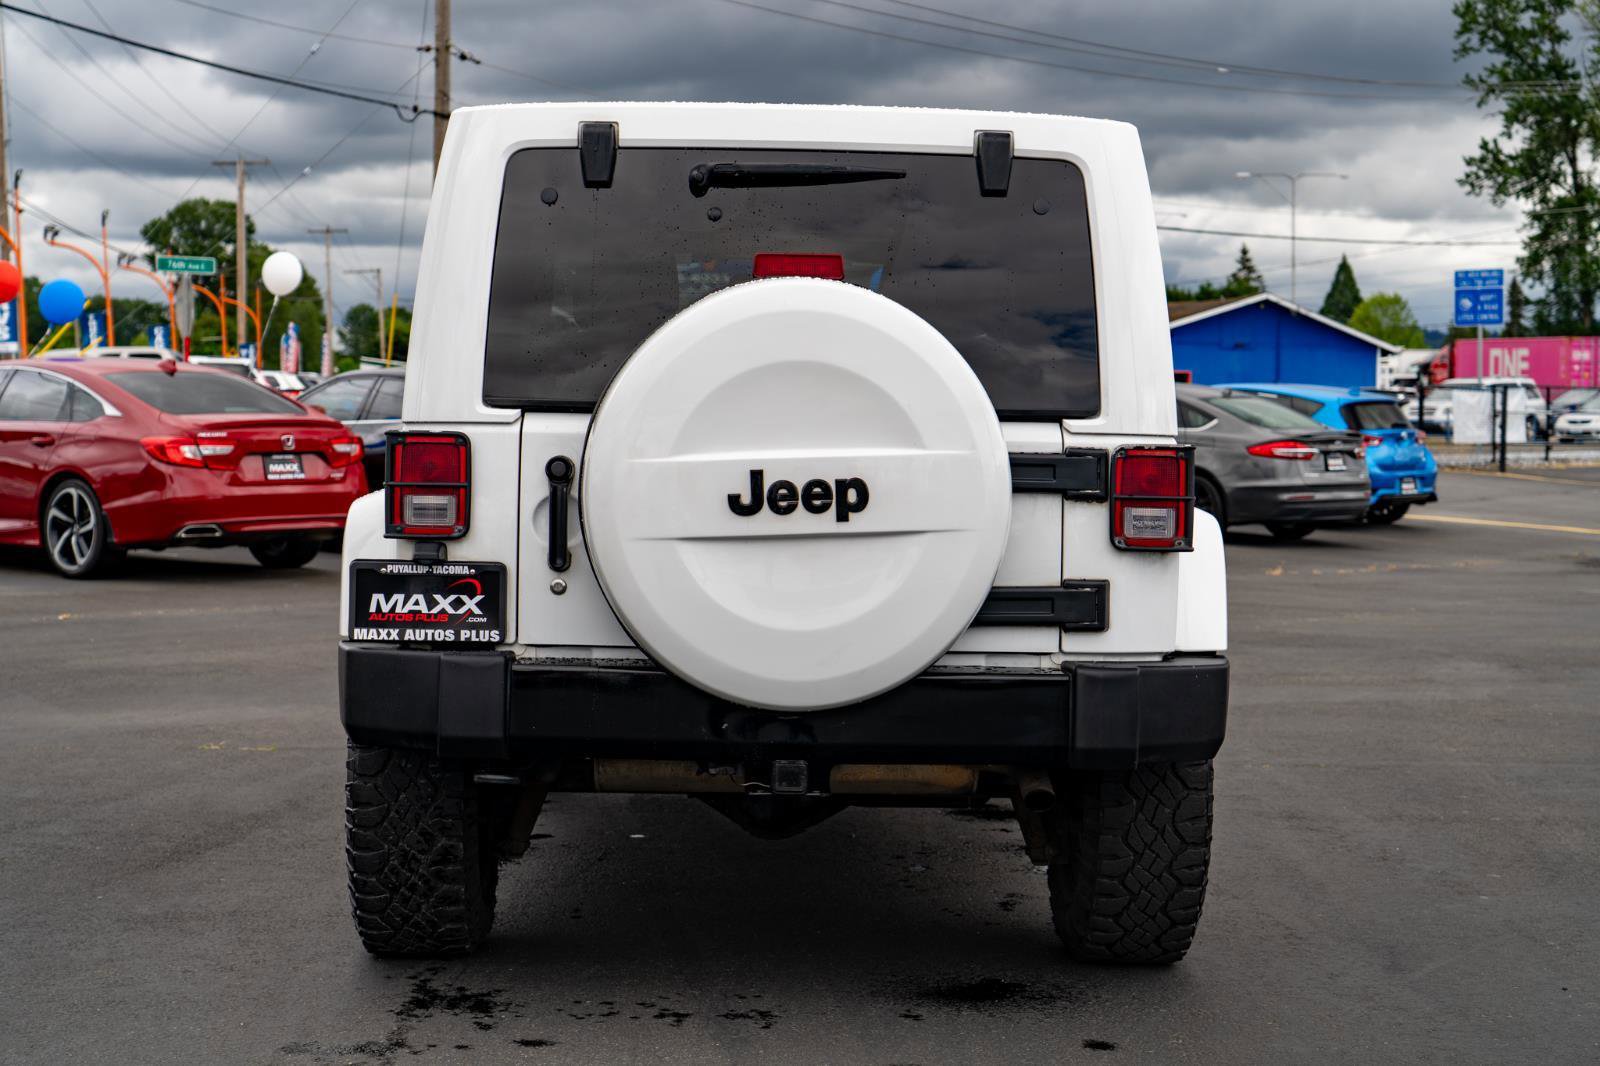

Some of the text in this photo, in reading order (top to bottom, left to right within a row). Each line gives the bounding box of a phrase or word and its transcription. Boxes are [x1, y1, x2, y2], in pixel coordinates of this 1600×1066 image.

[1489, 348, 1530, 377] ONE
[269, 463, 300, 472] MAXX
[727, 469, 870, 523] Jeep
[369, 593, 485, 614] MAXX
[368, 613, 449, 622] AUTOS PLUS
[354, 628, 500, 642] MAXX AUTOS PLUS
